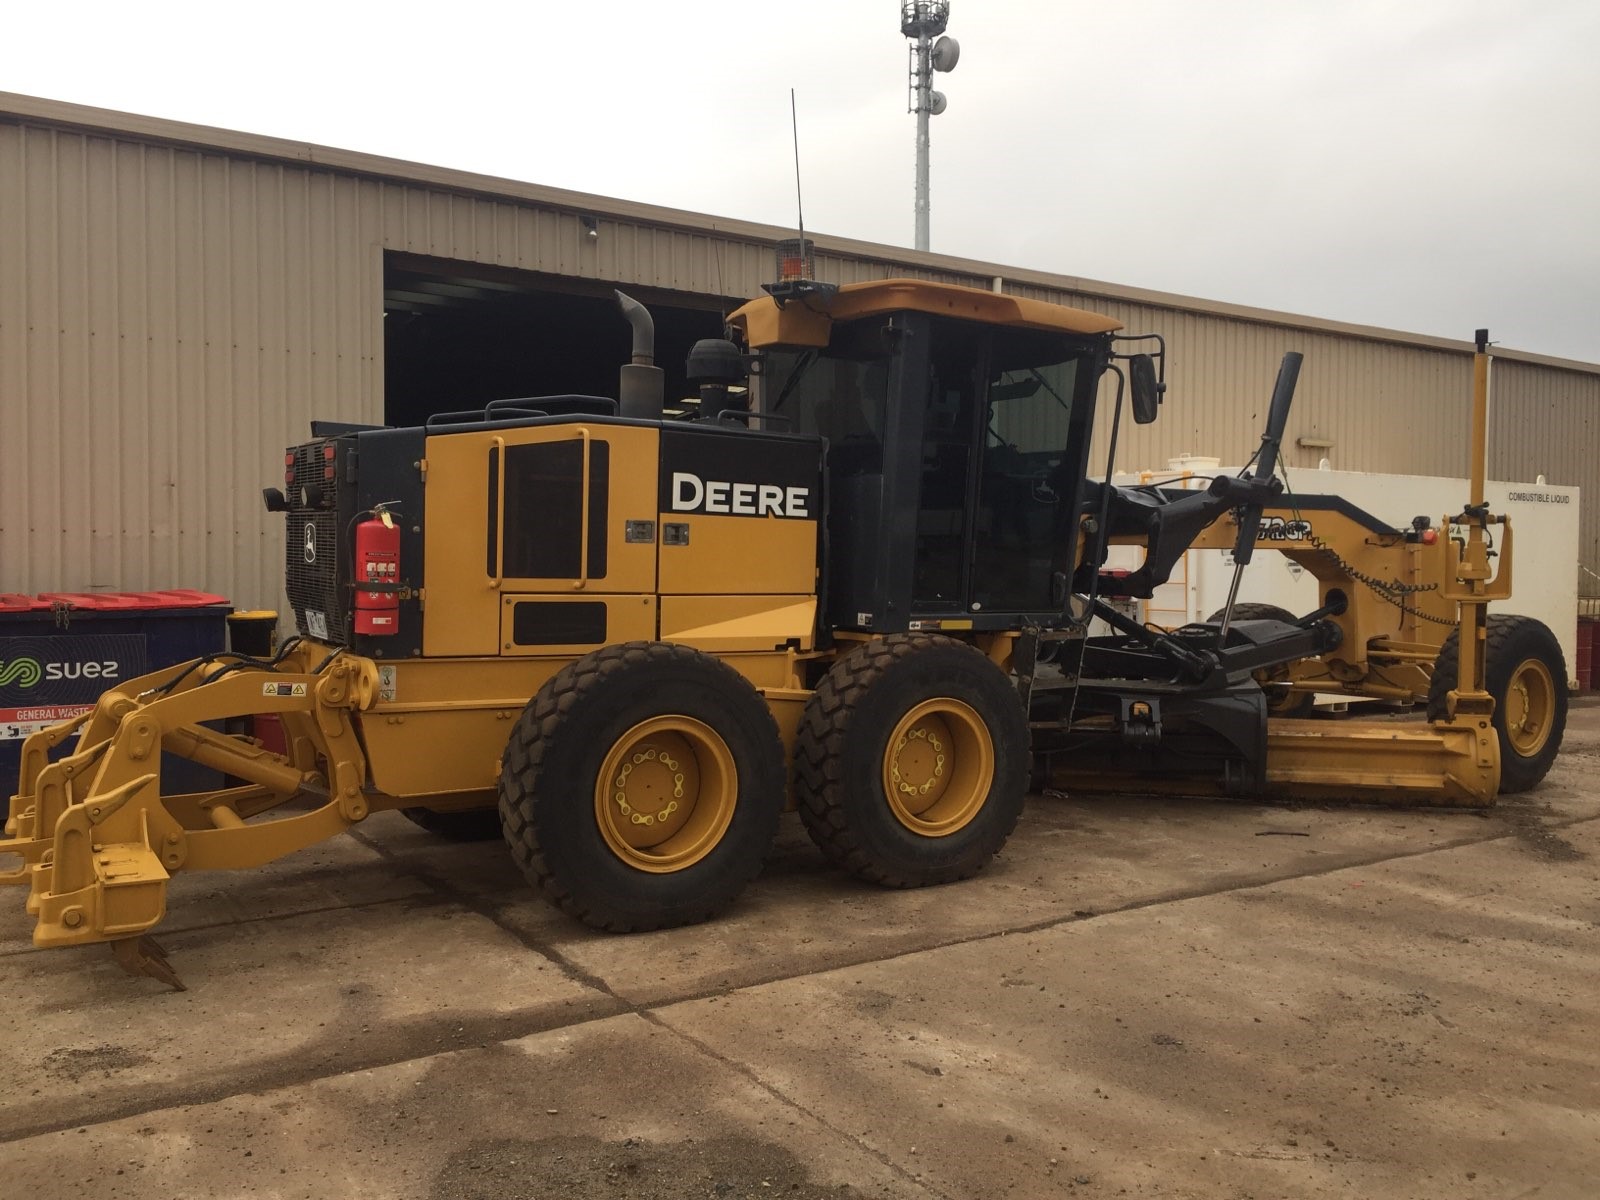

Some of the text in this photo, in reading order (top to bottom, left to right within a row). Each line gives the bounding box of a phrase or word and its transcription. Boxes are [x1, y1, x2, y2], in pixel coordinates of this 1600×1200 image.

[672, 472, 809, 517] DEERE
[1508, 492, 1570, 504] COMBUSTIBLE LIQUID
[16, 710, 57, 721] GENERAL
